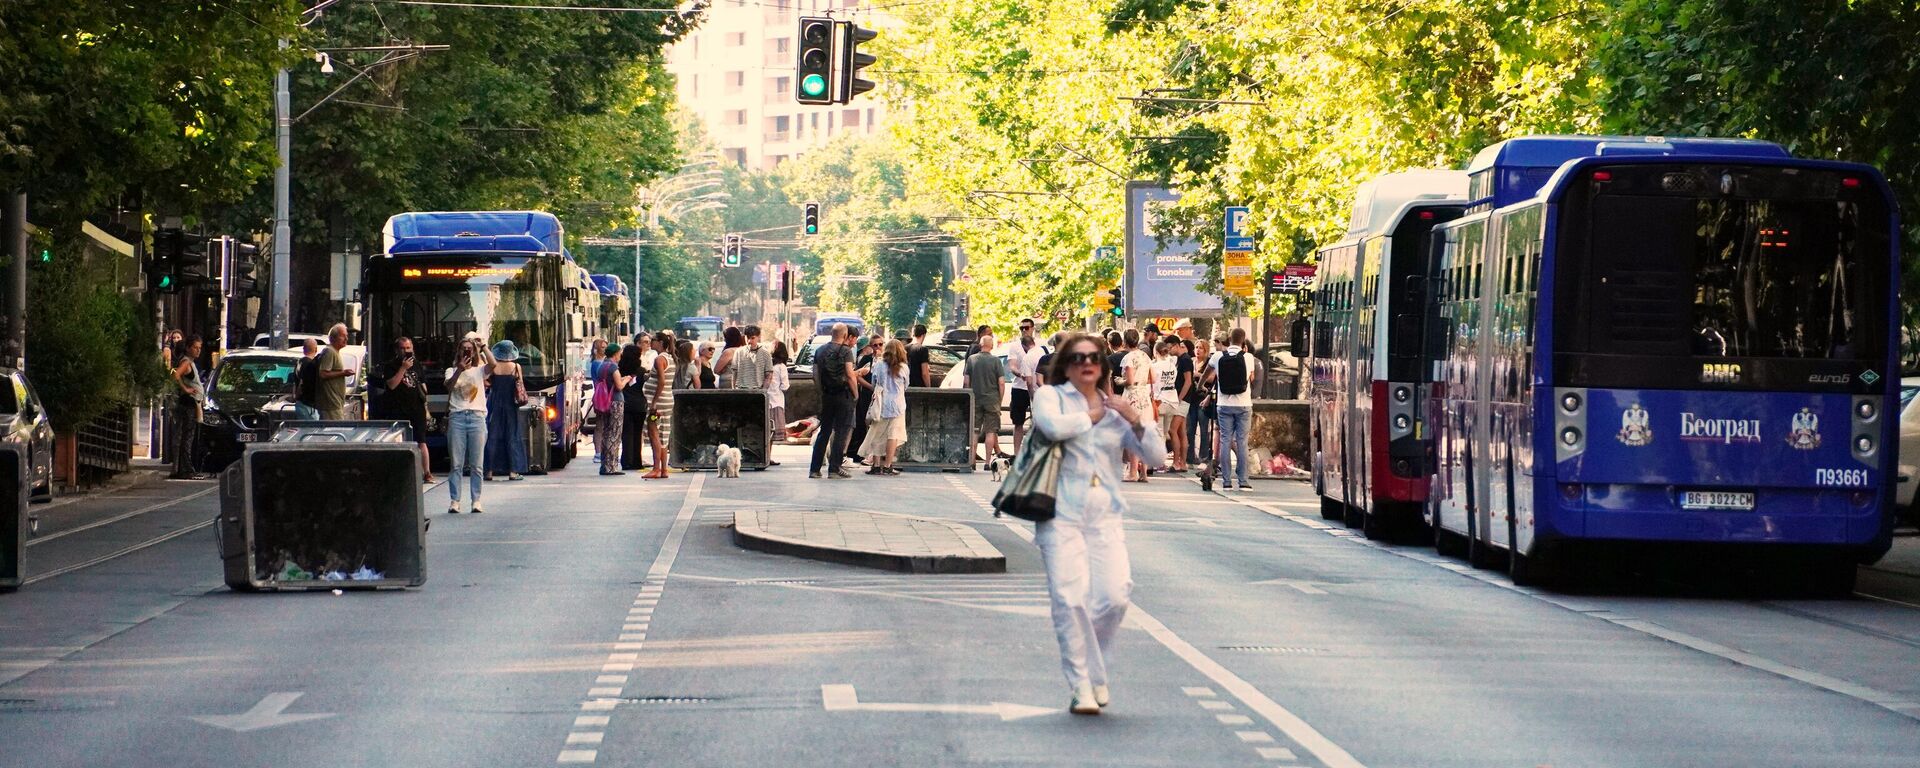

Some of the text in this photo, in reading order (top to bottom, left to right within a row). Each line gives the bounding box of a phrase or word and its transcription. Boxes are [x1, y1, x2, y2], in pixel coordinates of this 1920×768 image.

[1156, 268, 1194, 276] konobar
[1160, 319, 1174, 331] 20
[1702, 363, 1741, 383] BMC
[1808, 373, 1850, 383] euro6
[1680, 412, 1761, 444] Београд
[1816, 468, 1868, 486] П93661
[1687, 492, 1702, 505] BG
